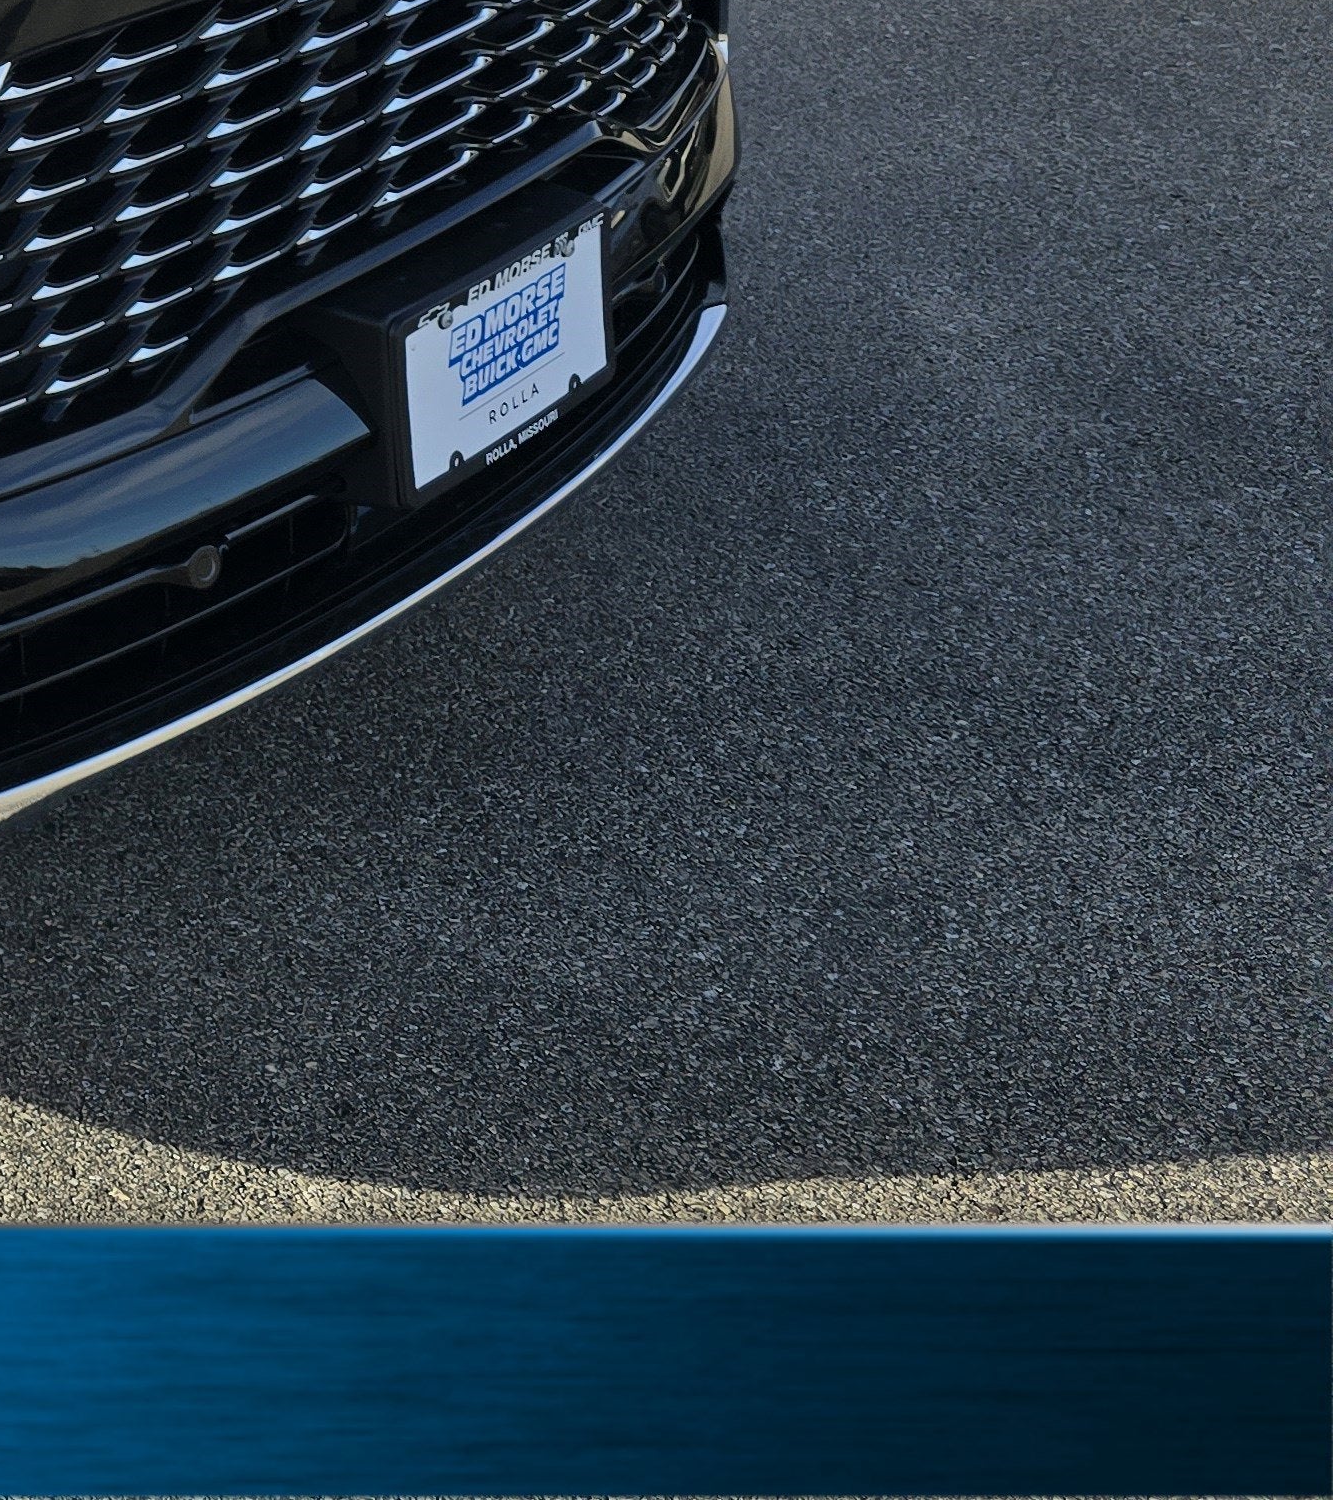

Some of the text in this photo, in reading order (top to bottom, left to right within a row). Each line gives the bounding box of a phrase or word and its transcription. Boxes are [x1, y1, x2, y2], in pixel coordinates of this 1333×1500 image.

[467, 277, 492, 304] ED
[494, 240, 552, 291] MORSE
[450, 266, 566, 362] ED MORSE
[459, 299, 561, 377] CHEVROLET
[488, 382, 540, 425] ROLLA
[518, 408, 560, 448] MISSOURI
